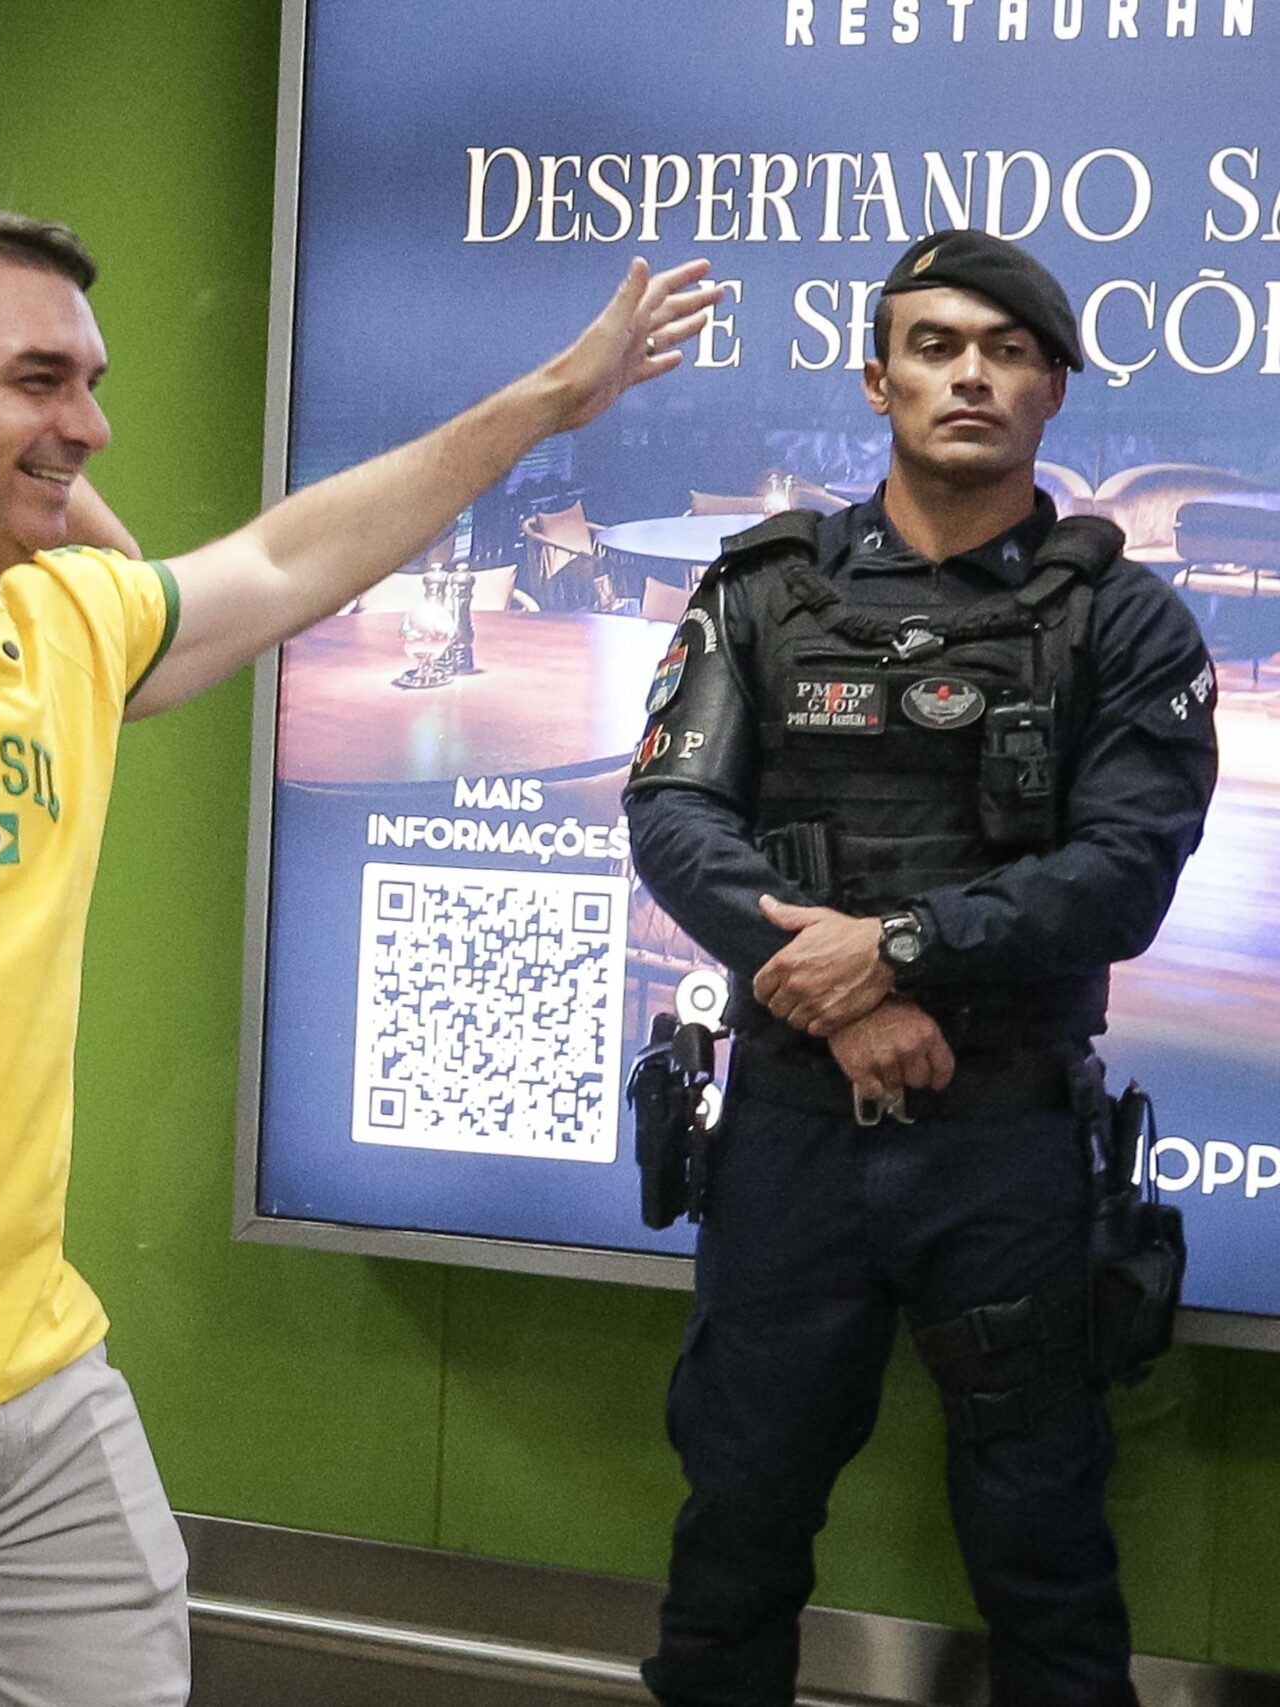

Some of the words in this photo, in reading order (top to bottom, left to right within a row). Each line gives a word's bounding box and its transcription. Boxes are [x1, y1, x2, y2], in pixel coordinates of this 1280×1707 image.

[463, 146, 1153, 243] DESPERTANDO
[1205, 147, 1280, 242] S
[694, 279, 743, 368] E
[453, 776, 545, 812] MAIS
[367, 813, 631, 864] INFORMAÇÕES
